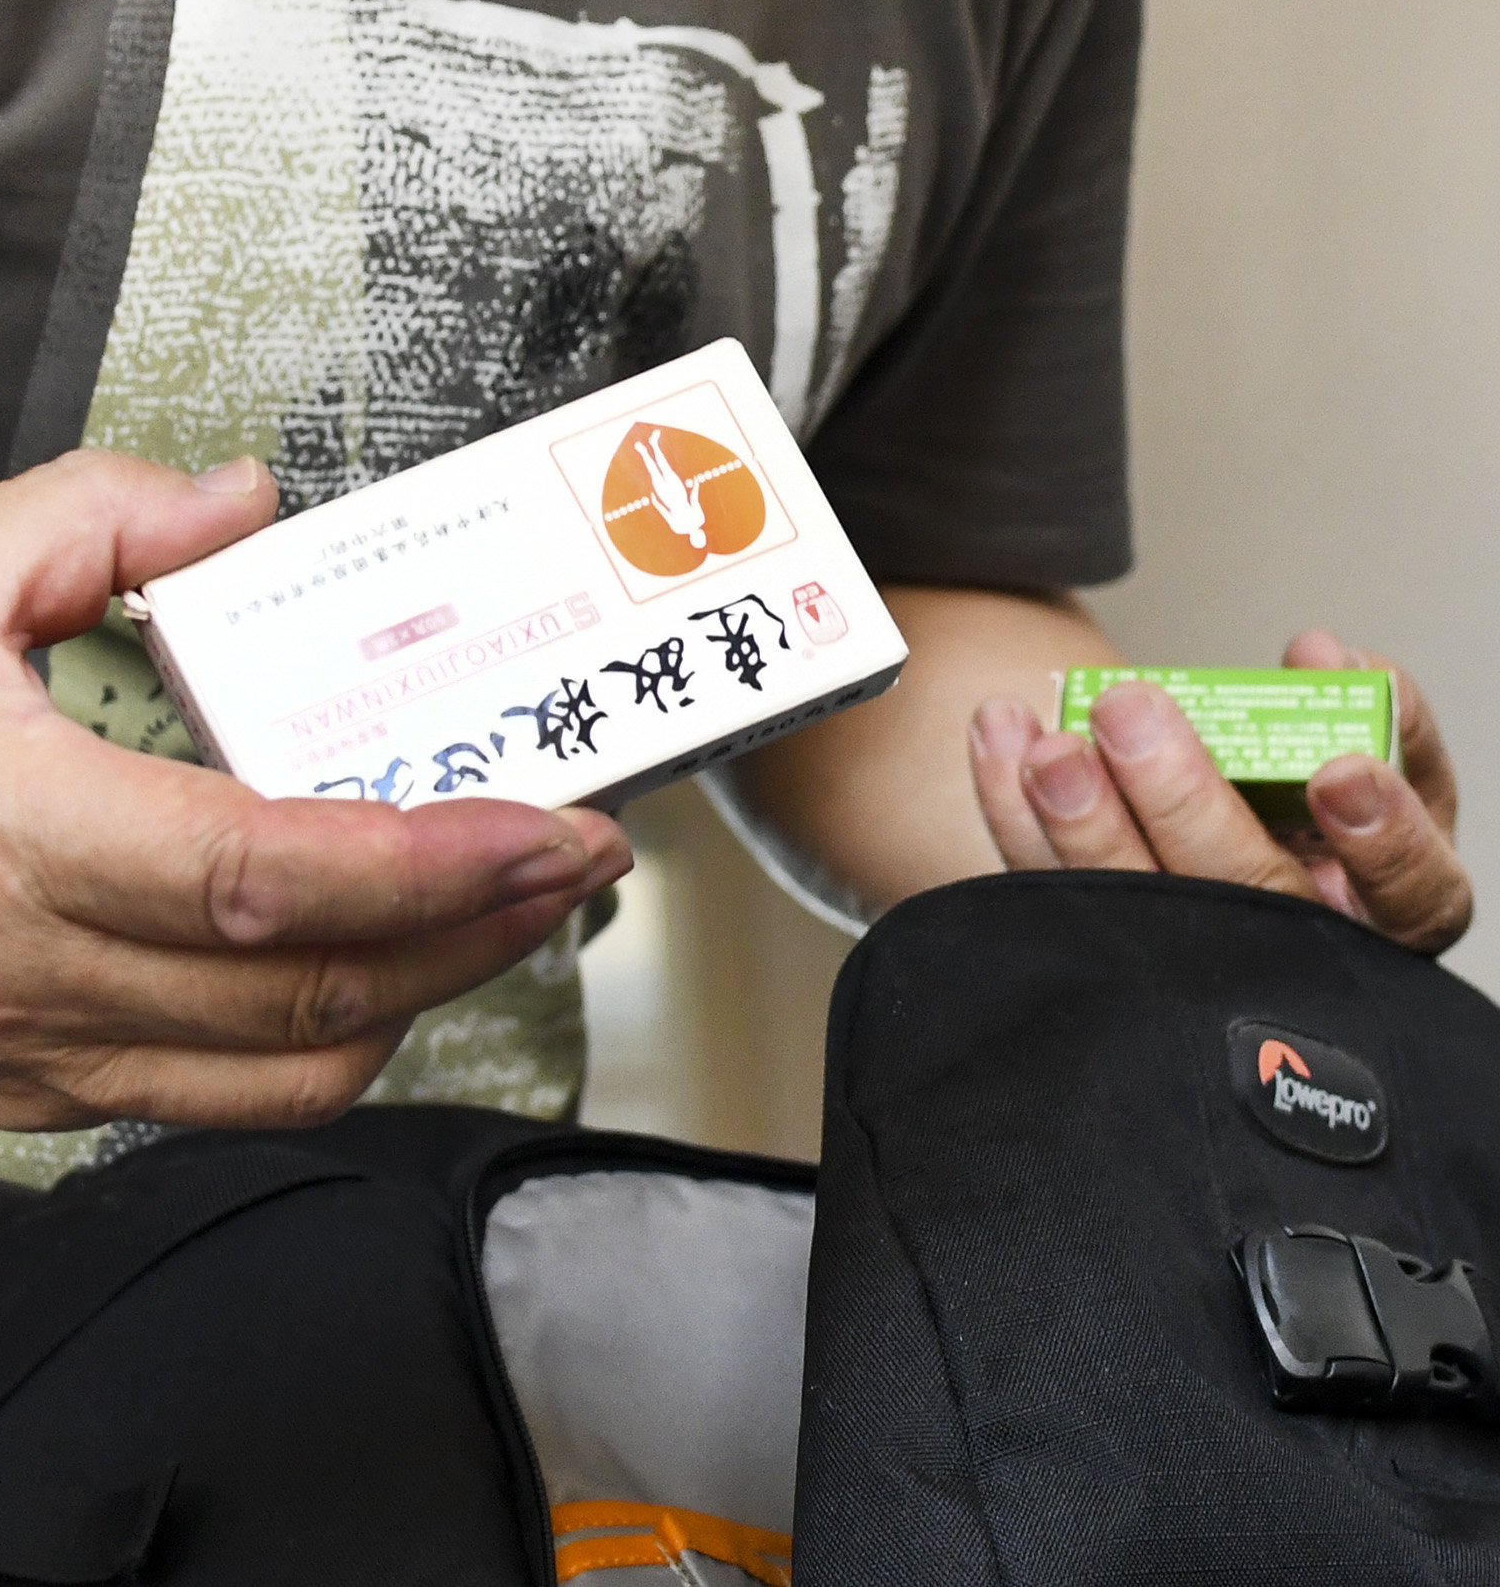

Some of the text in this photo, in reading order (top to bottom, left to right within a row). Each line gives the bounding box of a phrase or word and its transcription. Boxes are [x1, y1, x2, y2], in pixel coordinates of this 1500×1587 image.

[226, 496, 510, 625] 天津中新药业集团股份有限公司
[314, 593, 791, 804] 速效救心丸
[1273, 1068, 1372, 1130] Lowepro
